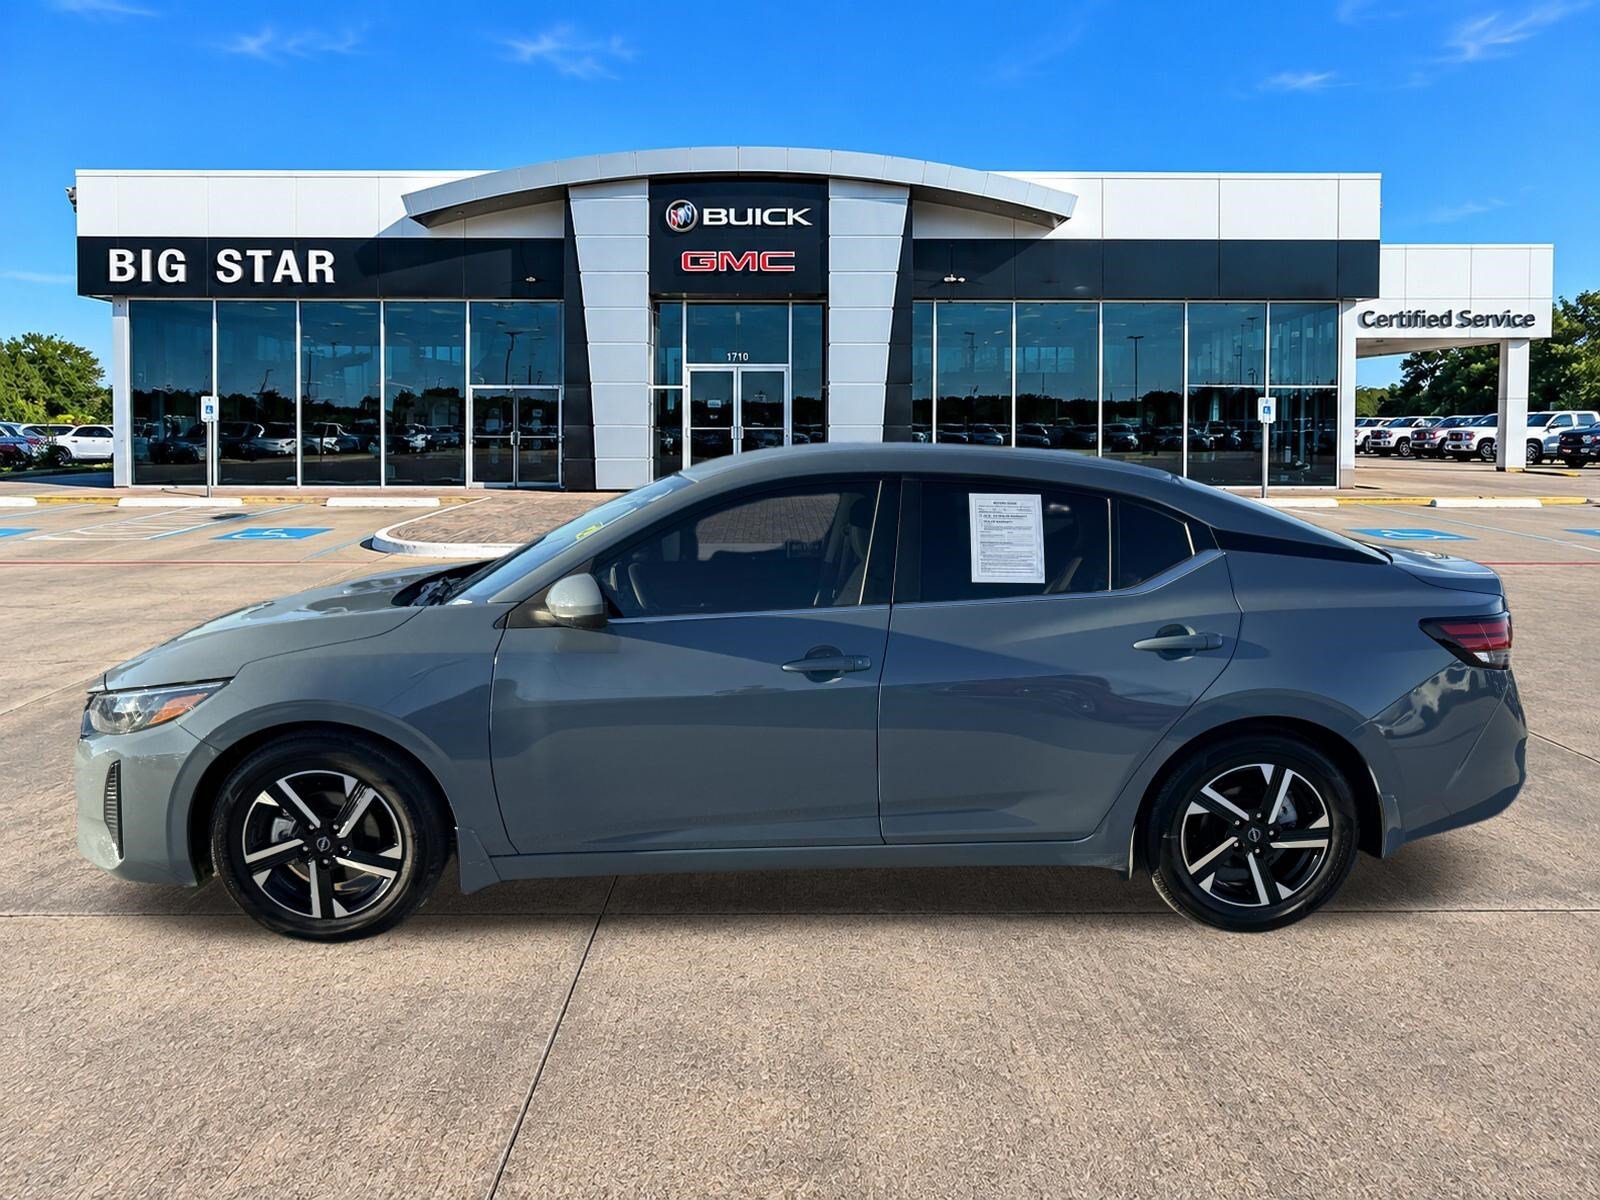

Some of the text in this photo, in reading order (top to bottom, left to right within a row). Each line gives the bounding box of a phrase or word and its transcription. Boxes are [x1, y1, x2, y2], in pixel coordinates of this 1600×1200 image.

[702, 208, 813, 226] BUICK
[108, 248, 336, 284] BIG STAR
[681, 250, 796, 272] GMC
[1360, 310, 1536, 328] Certified Service
[727, 352, 749, 361] 1710
